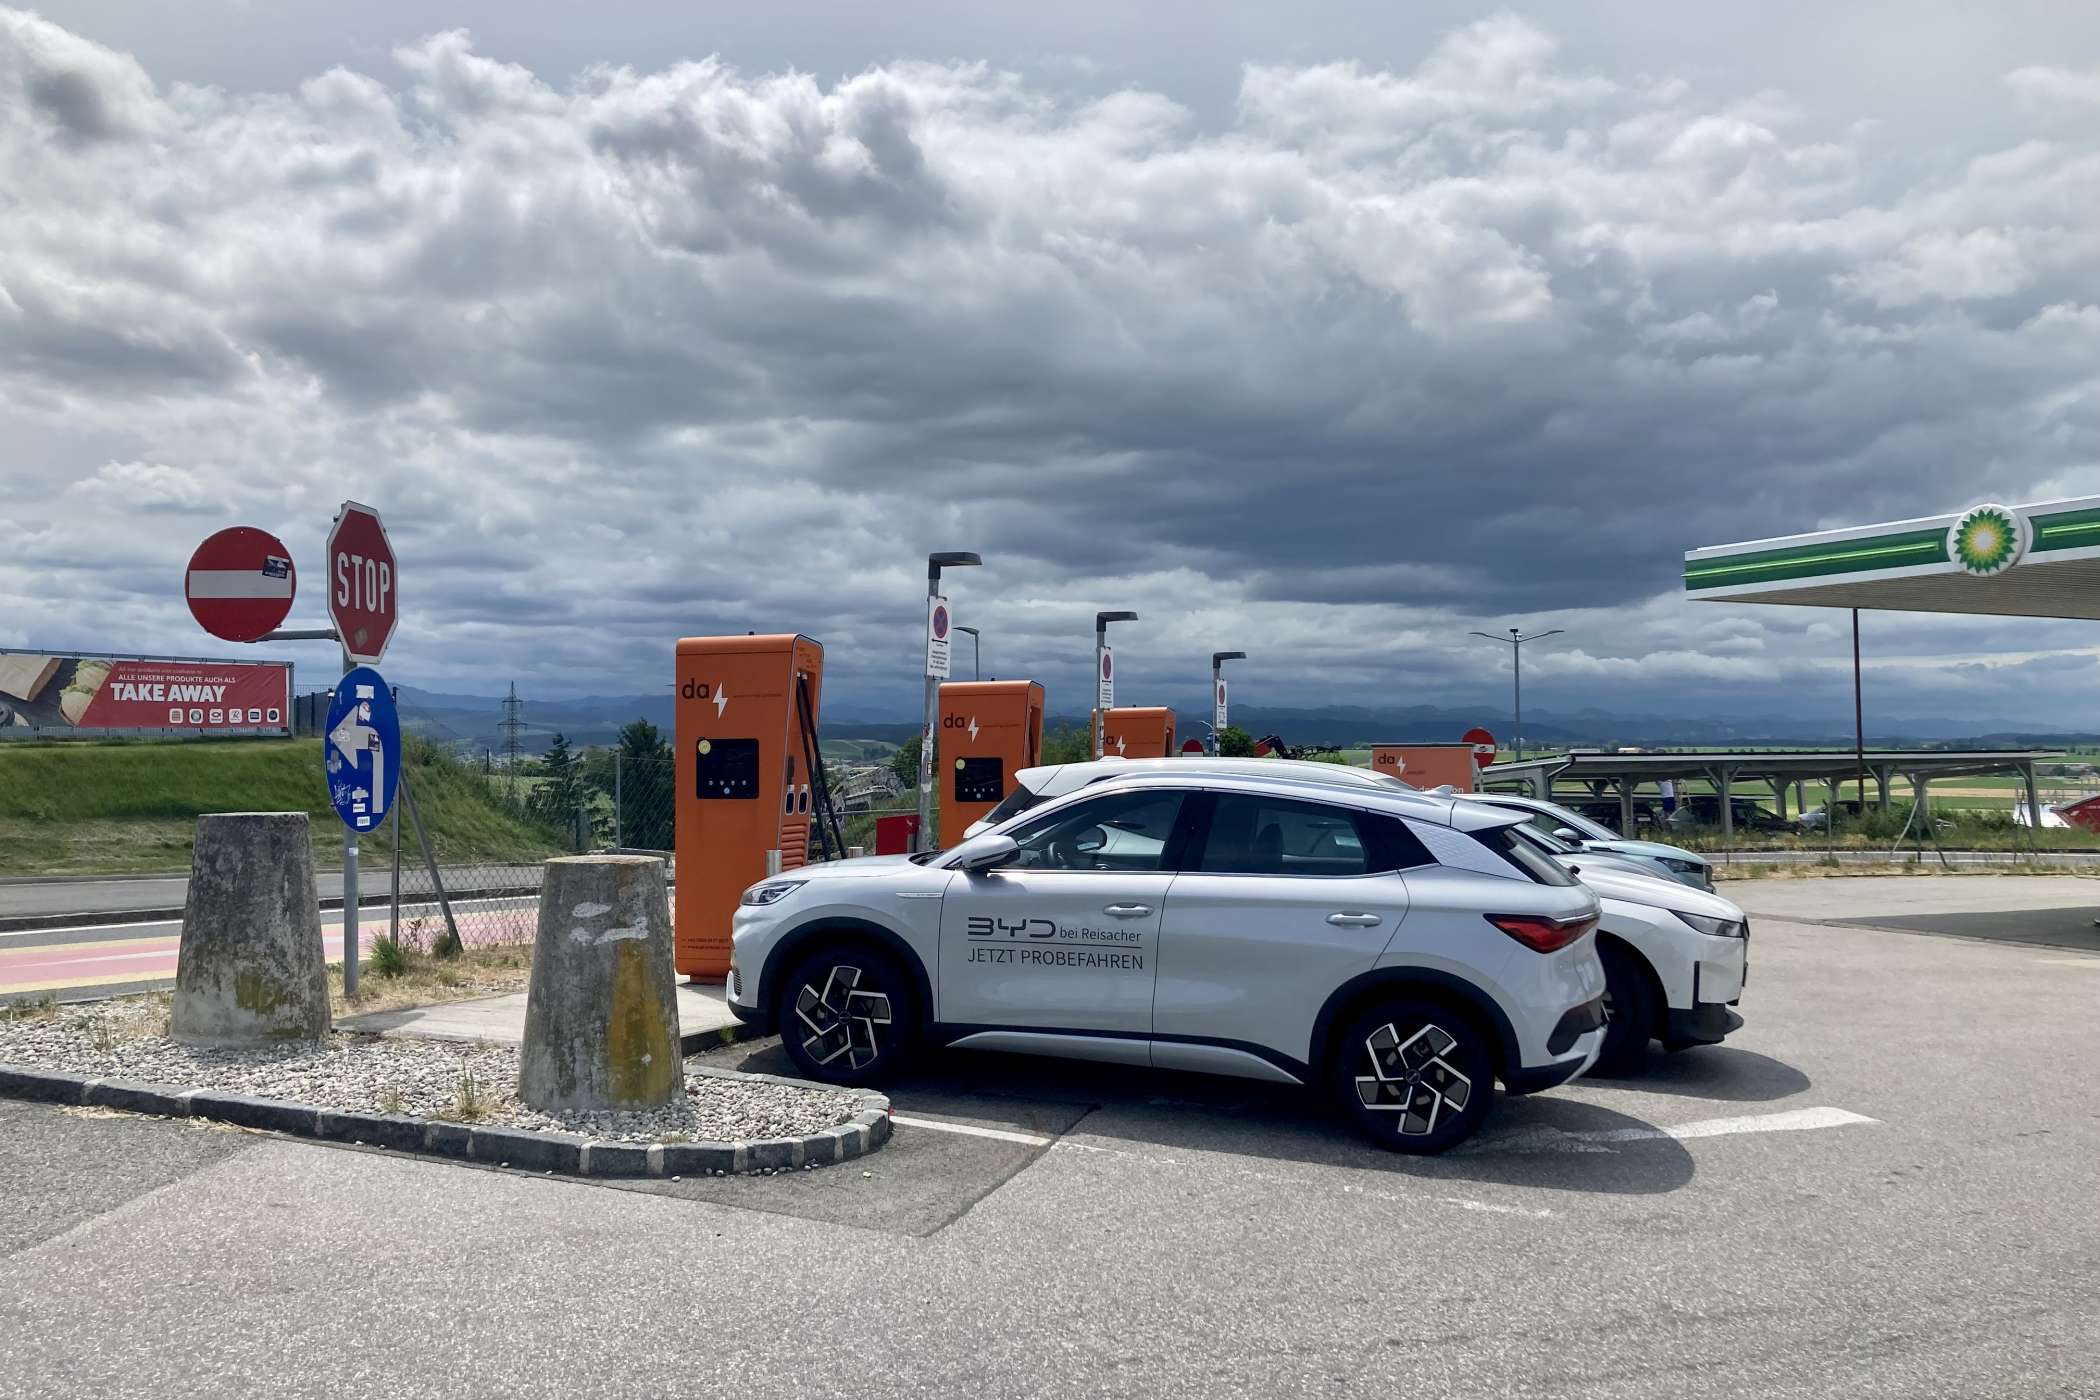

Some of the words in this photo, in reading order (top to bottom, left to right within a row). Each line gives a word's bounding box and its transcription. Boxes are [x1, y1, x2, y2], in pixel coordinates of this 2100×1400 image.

[337, 552, 390, 614] STOP
[166, 675, 203, 683] PRODUKTE
[682, 678, 710, 699] da
[110, 683, 165, 702] TAKE
[167, 684, 226, 702] AWAY
[943, 712, 965, 728] da
[1378, 753, 1396, 765] da
[968, 916, 1056, 938] BYD
[1060, 926, 1078, 939] bei
[1081, 927, 1142, 942] Reisacher
[968, 947, 1016, 963] JETZT
[1021, 950, 1143, 969] PROBEFAHREN
